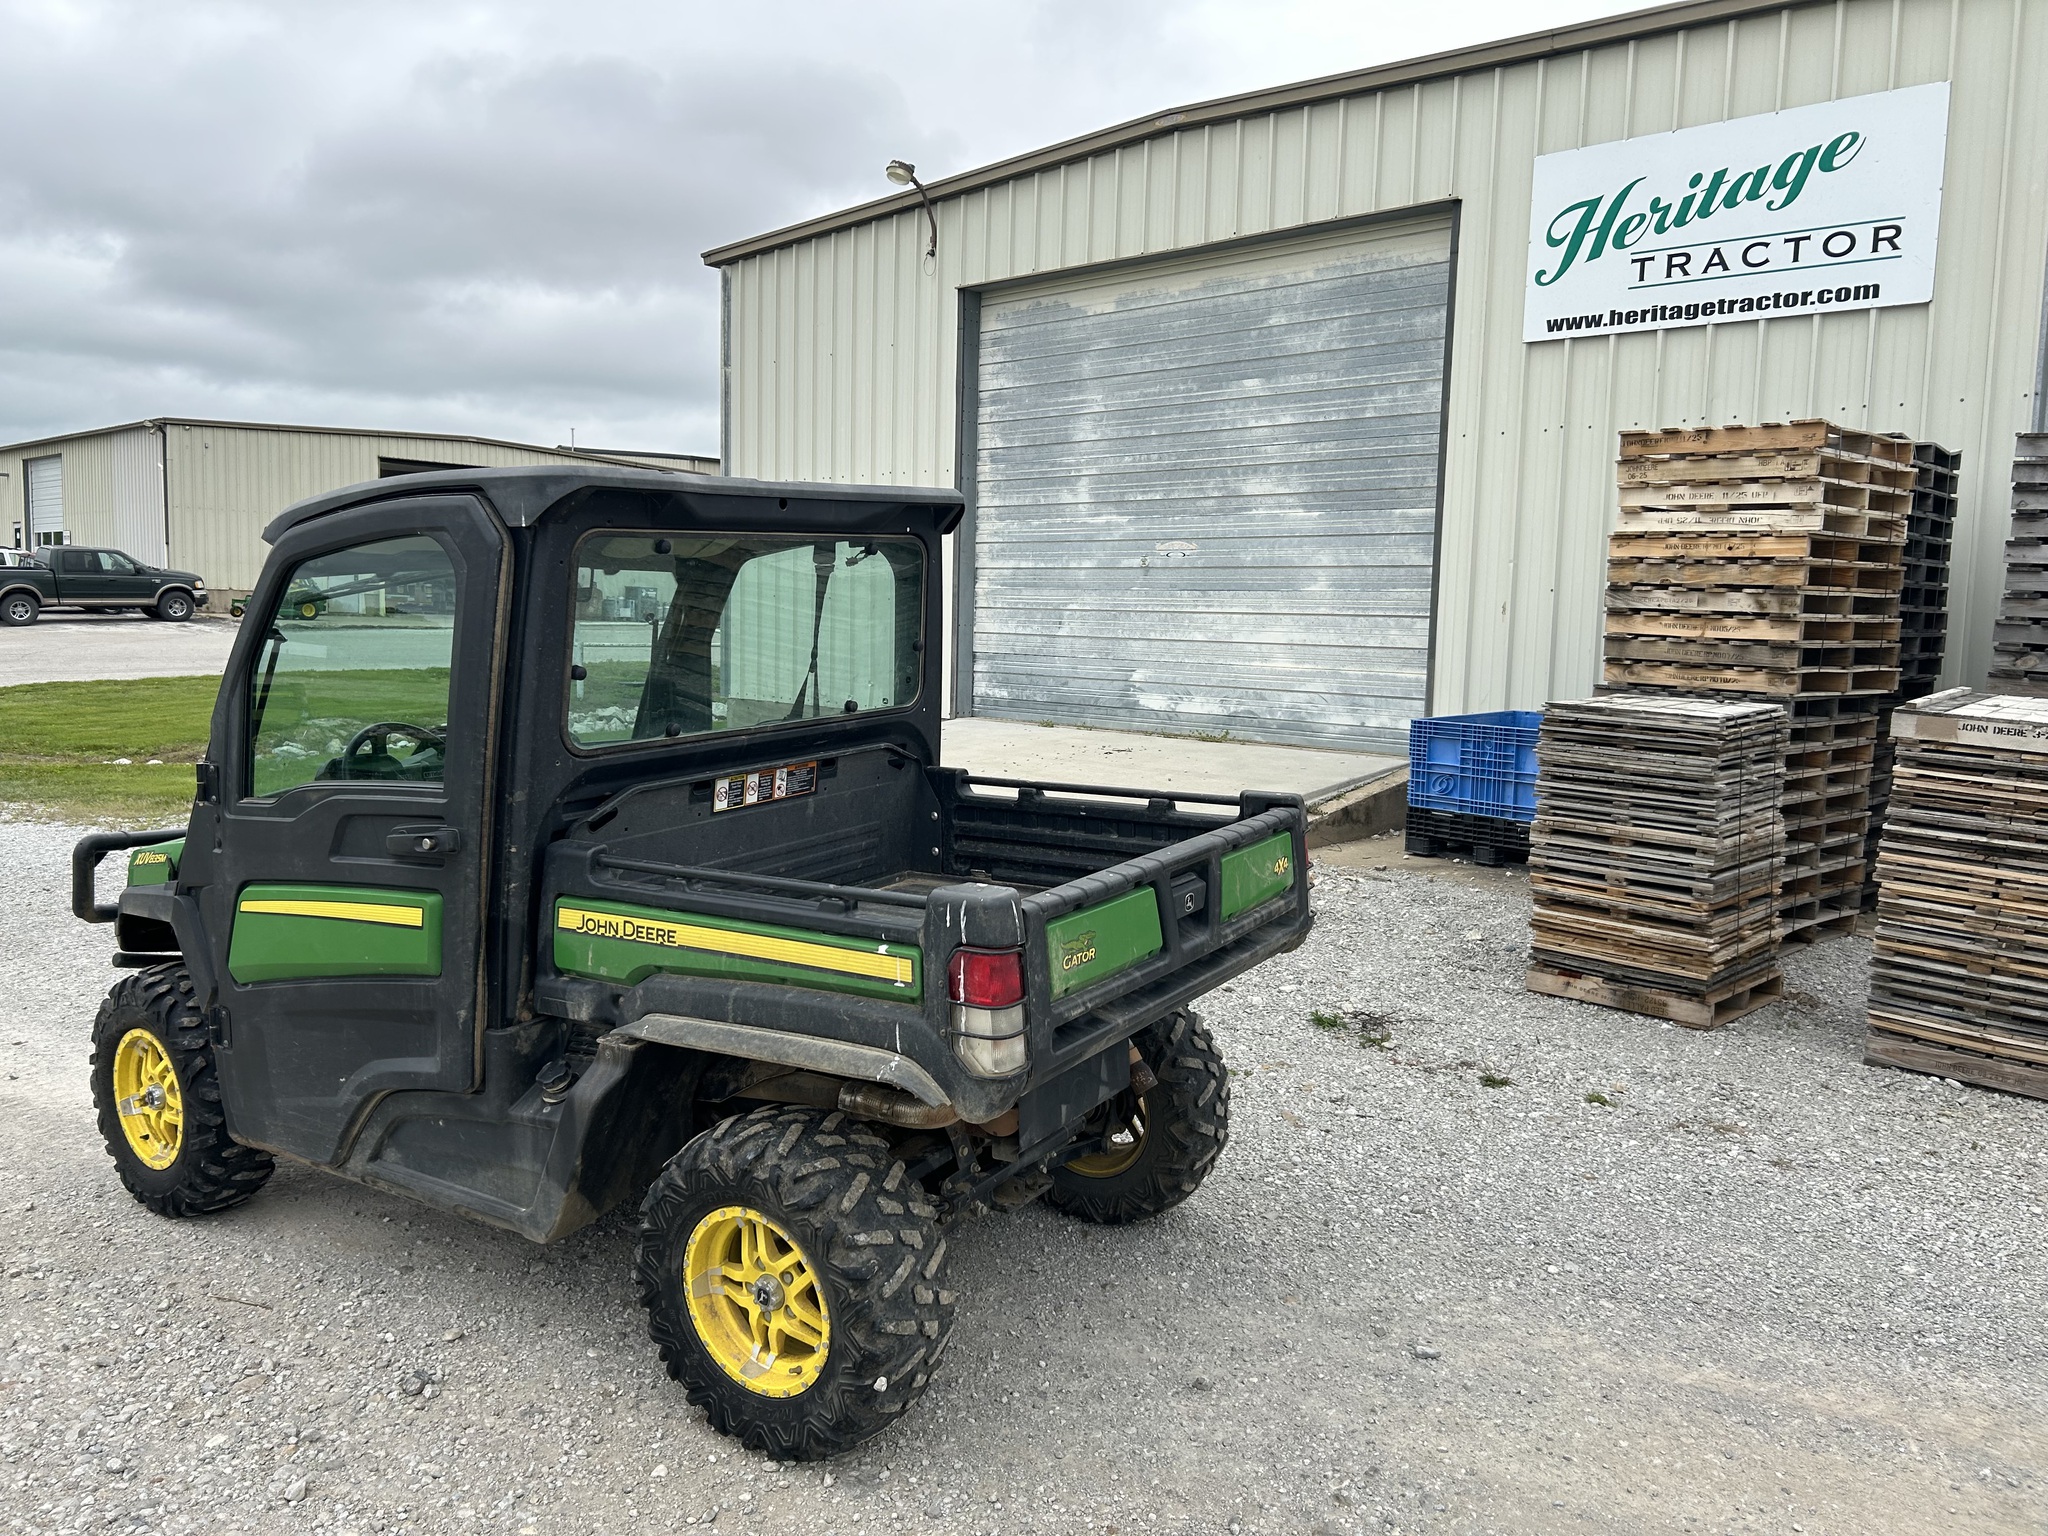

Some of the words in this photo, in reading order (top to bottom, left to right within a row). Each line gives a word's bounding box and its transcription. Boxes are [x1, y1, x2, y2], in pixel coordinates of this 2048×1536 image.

[1535, 131, 1867, 287] Heritage
[1631, 224, 1903, 283] TRACTOR
[1546, 282, 1880, 333] www.heritagetractor.com
[1627, 472, 1648, 480] 06-25
[1663, 493, 1686, 501] JOHN
[1688, 492, 1715, 500] DEERE
[1958, 723, 1989, 734] JOHN
[1993, 726, 2028, 738] DEERE
[576, 914, 619, 937] JOHN
[623, 920, 677, 945] DEERE
[1063, 947, 1096, 970] GATOR
